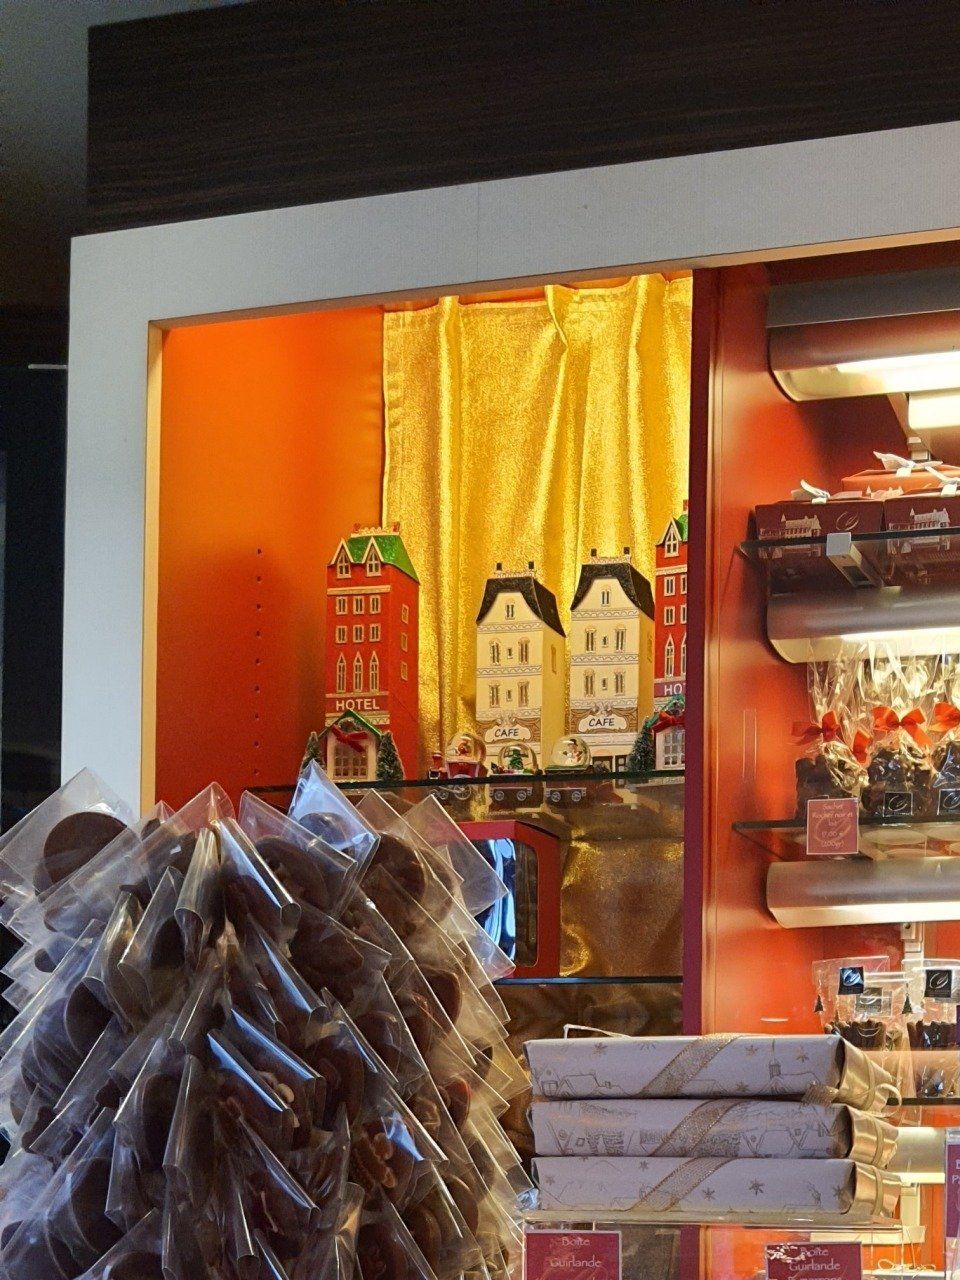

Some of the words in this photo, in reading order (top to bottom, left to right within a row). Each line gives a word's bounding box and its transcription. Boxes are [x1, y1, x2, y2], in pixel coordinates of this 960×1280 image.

[335, 698, 380, 711] HOTEL
[588, 718, 615, 728] CAFE
[494, 728, 519, 738] CAFE
[550, 1255, 602, 1268] Guirlande
[789, 1258, 841, 1271] Guirlande
